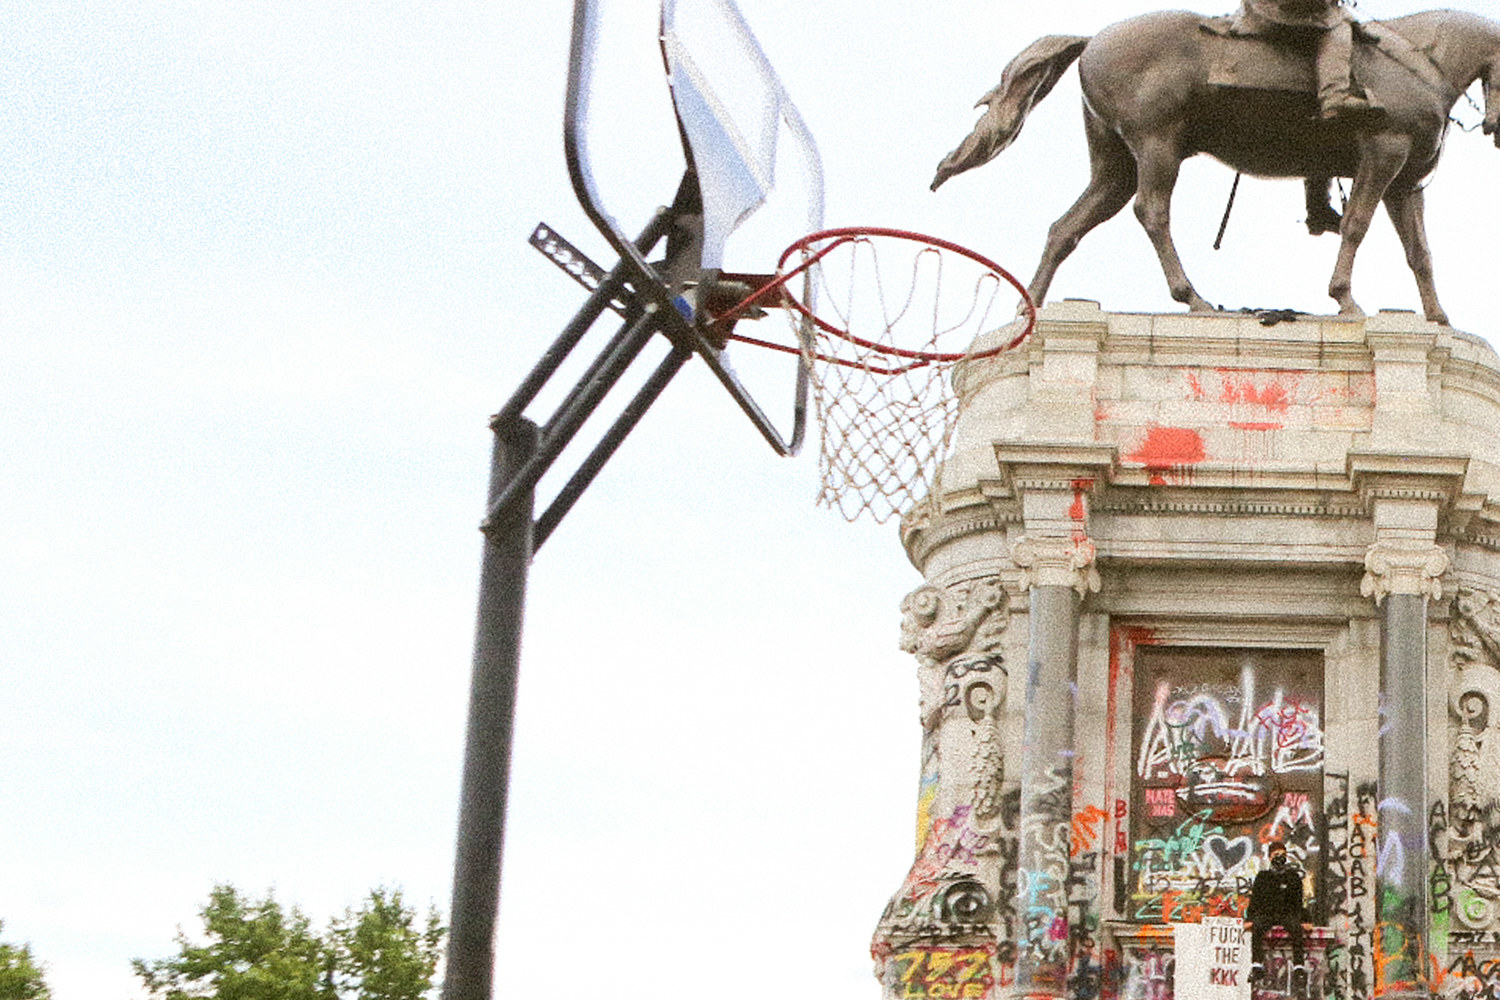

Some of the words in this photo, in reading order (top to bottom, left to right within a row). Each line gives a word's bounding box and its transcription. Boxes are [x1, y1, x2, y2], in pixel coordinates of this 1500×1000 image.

[1351, 824, 1368, 896] ACAB
[1209, 926, 1246, 945] FUCK
[1214, 946, 1241, 964] THE
[894, 951, 988, 982] 757
[1209, 967, 1240, 986] KKK
[902, 982, 984, 1000] LOVE
